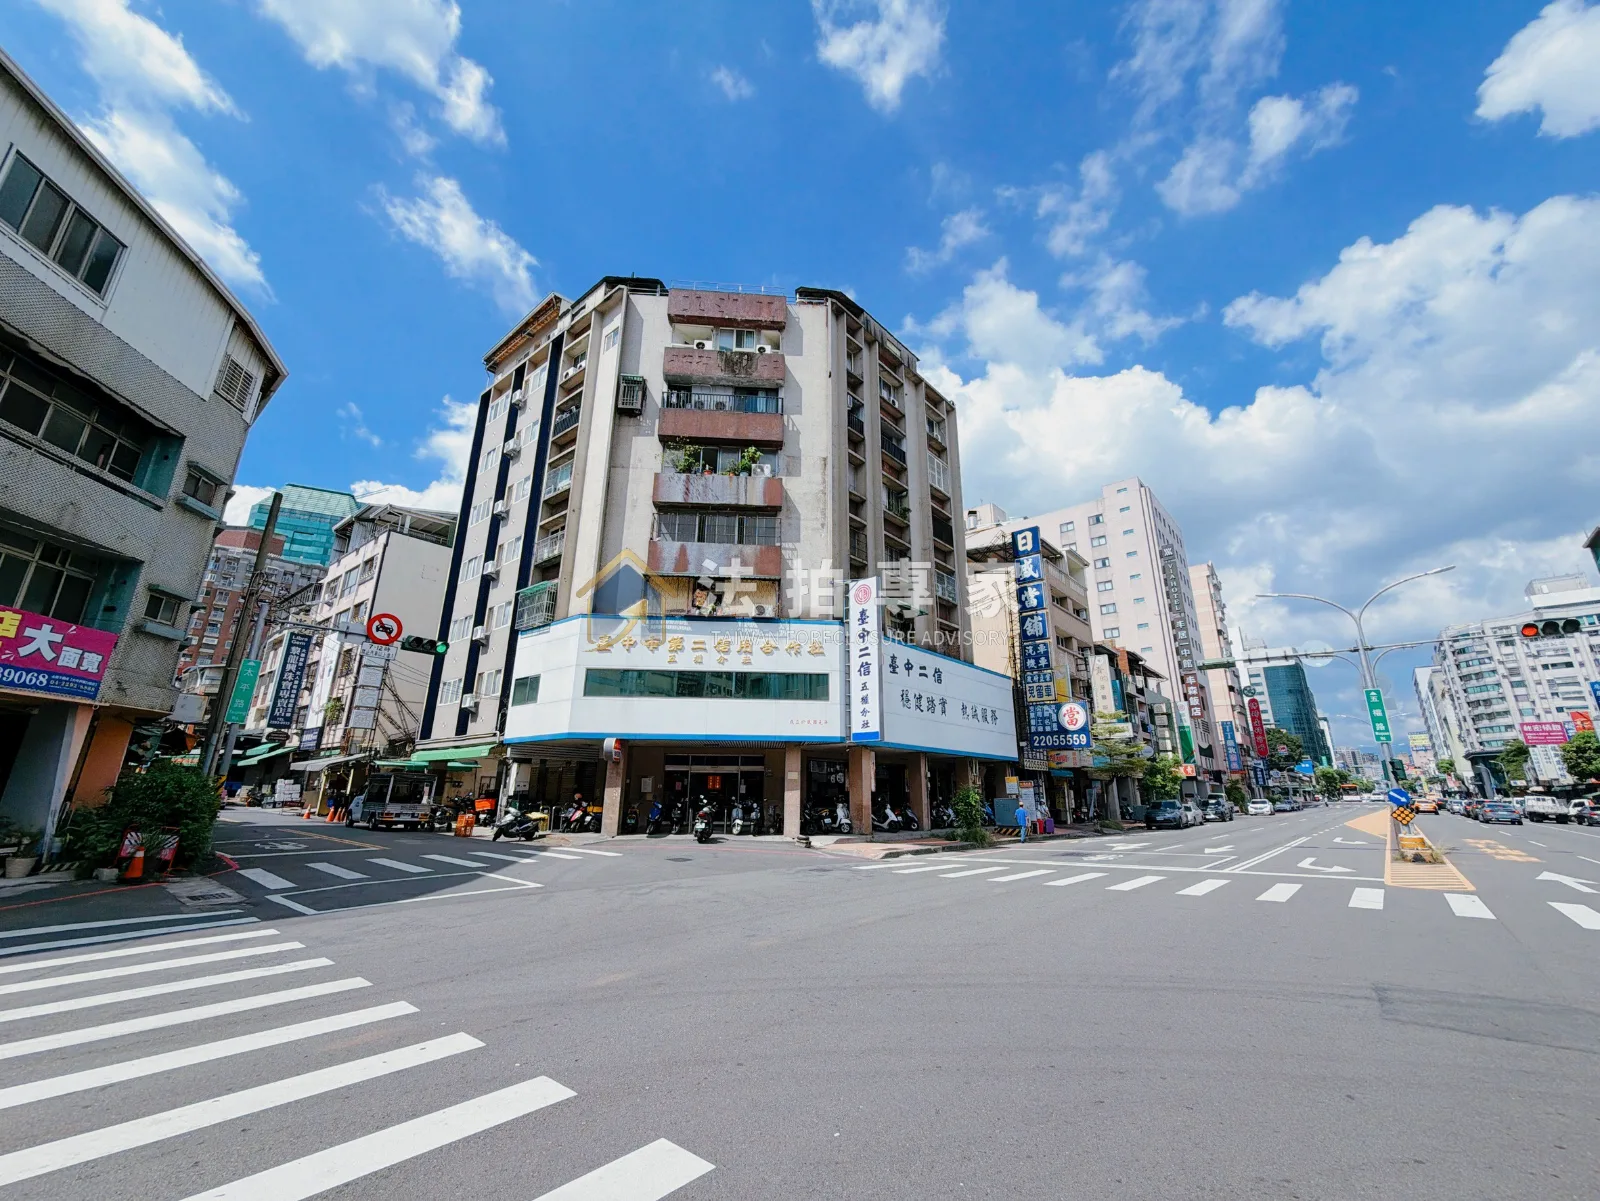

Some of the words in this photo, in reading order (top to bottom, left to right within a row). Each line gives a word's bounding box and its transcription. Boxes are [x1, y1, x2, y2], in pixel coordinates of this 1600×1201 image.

[1168, 563, 1176, 580] VIA
[1170, 581, 1180, 611] HOTEL
[857, 607, 872, 677] 臺中二信
[1025, 643, 1048, 657] 汽車
[888, 653, 943, 685] 臺中二信
[1026, 656, 1049, 669] 機車
[233, 668, 256, 708] 太平路
[1028, 684, 1052, 699] 免留車
[899, 689, 948, 717] 穩健踏實
[1063, 706, 1080, 727] 當
[1033, 733, 1087, 747] 22055559
